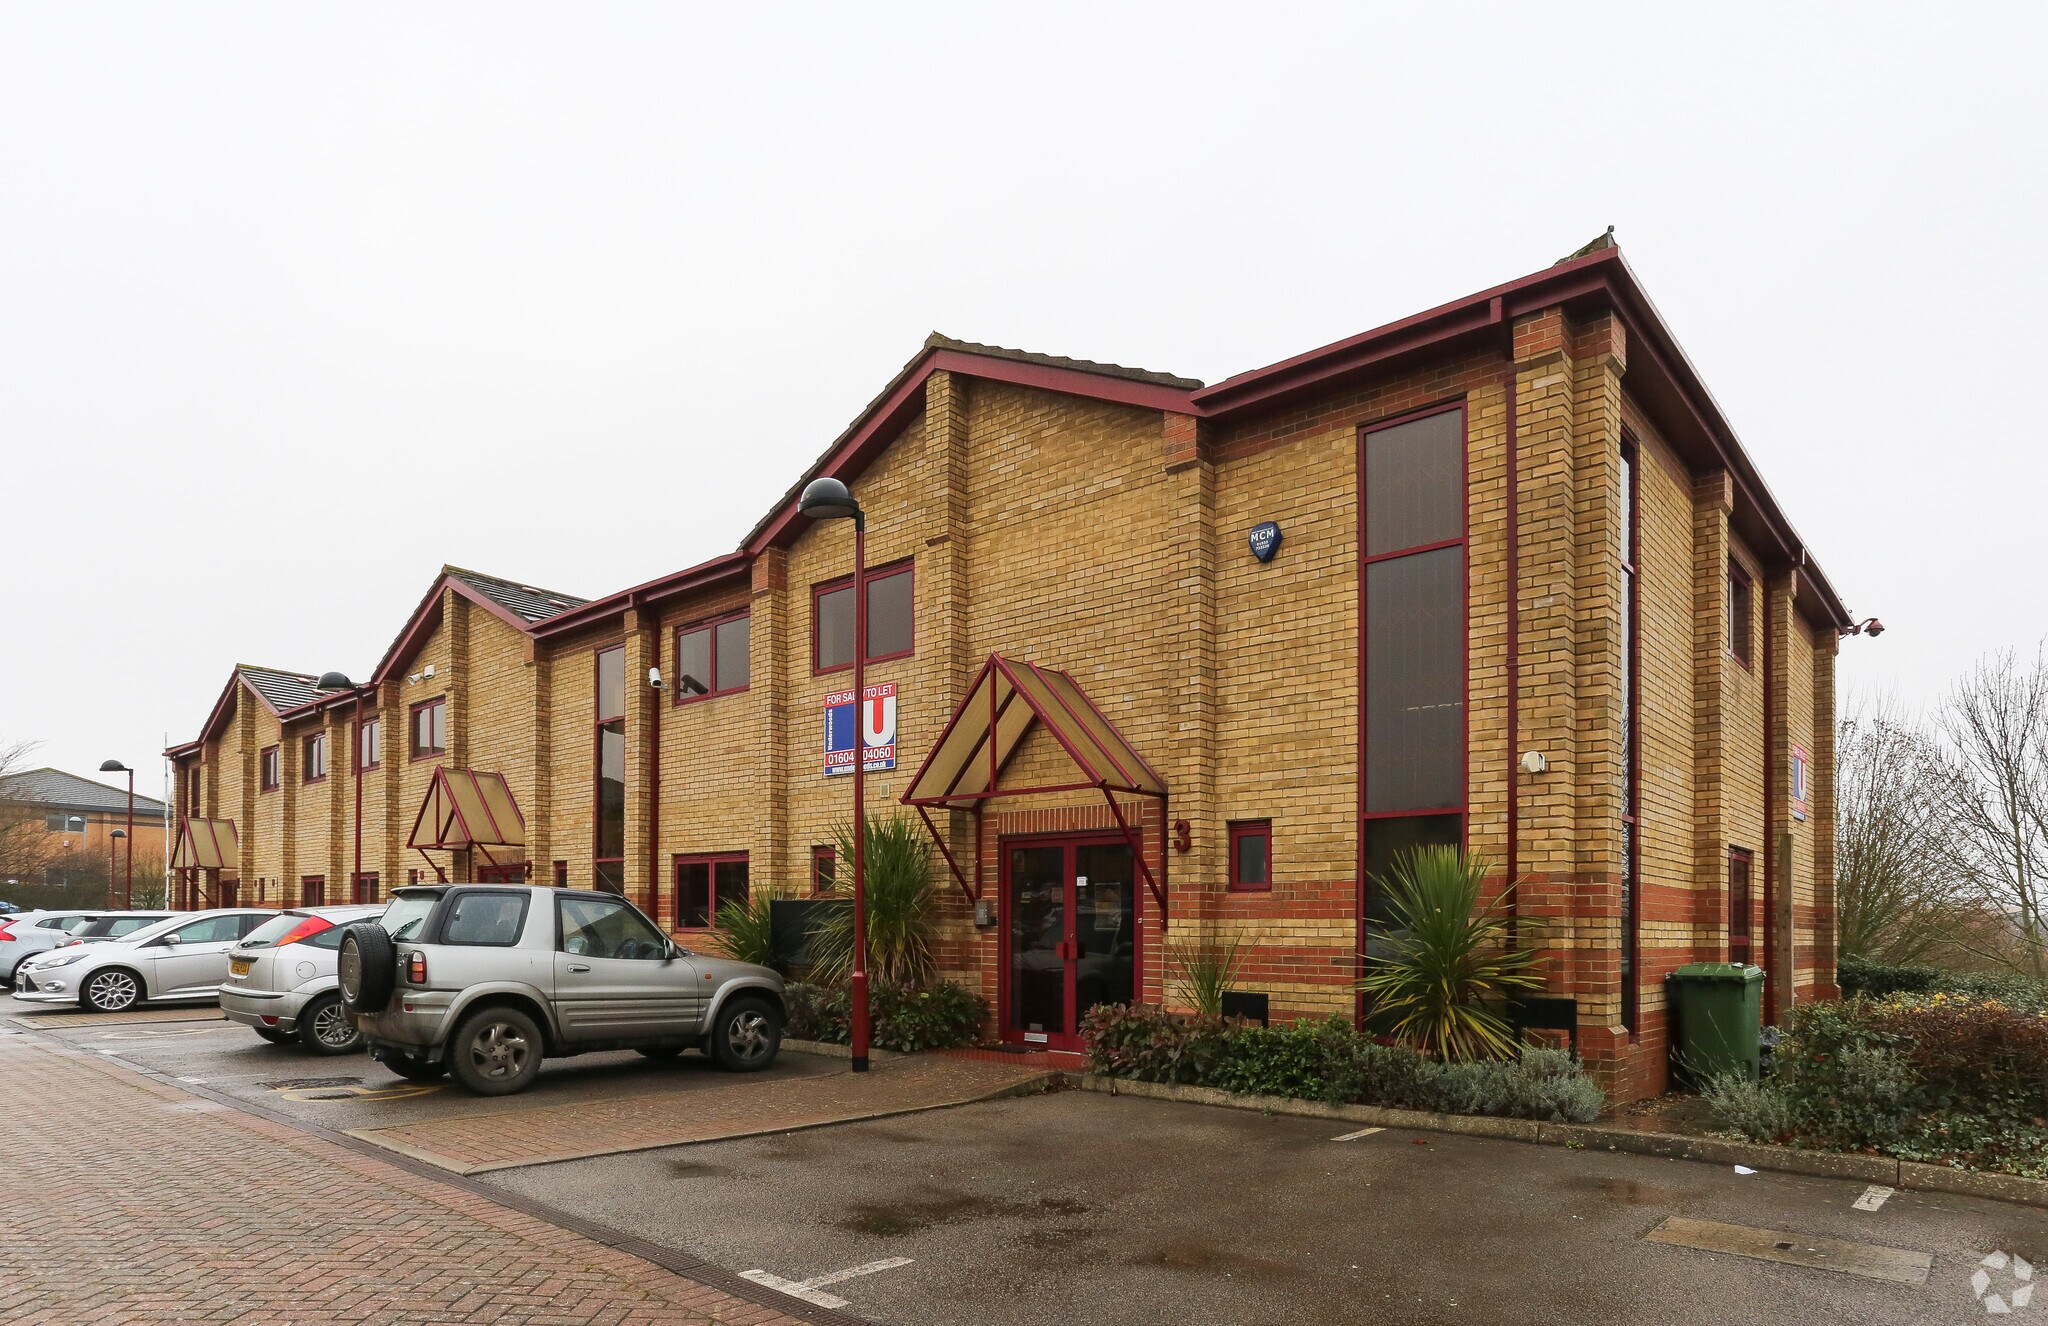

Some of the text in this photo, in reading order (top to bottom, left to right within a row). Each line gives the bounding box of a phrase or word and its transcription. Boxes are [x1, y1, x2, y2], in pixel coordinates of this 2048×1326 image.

[1251, 529, 1274, 542] MCM
[827, 694, 841, 704] FOR
[843, 691, 856, 702] SAL
[867, 687, 877, 698] TO
[878, 685, 892, 696] LET
[828, 747, 891, 764] 01604 04060
[1174, 819, 1191, 852] 3
